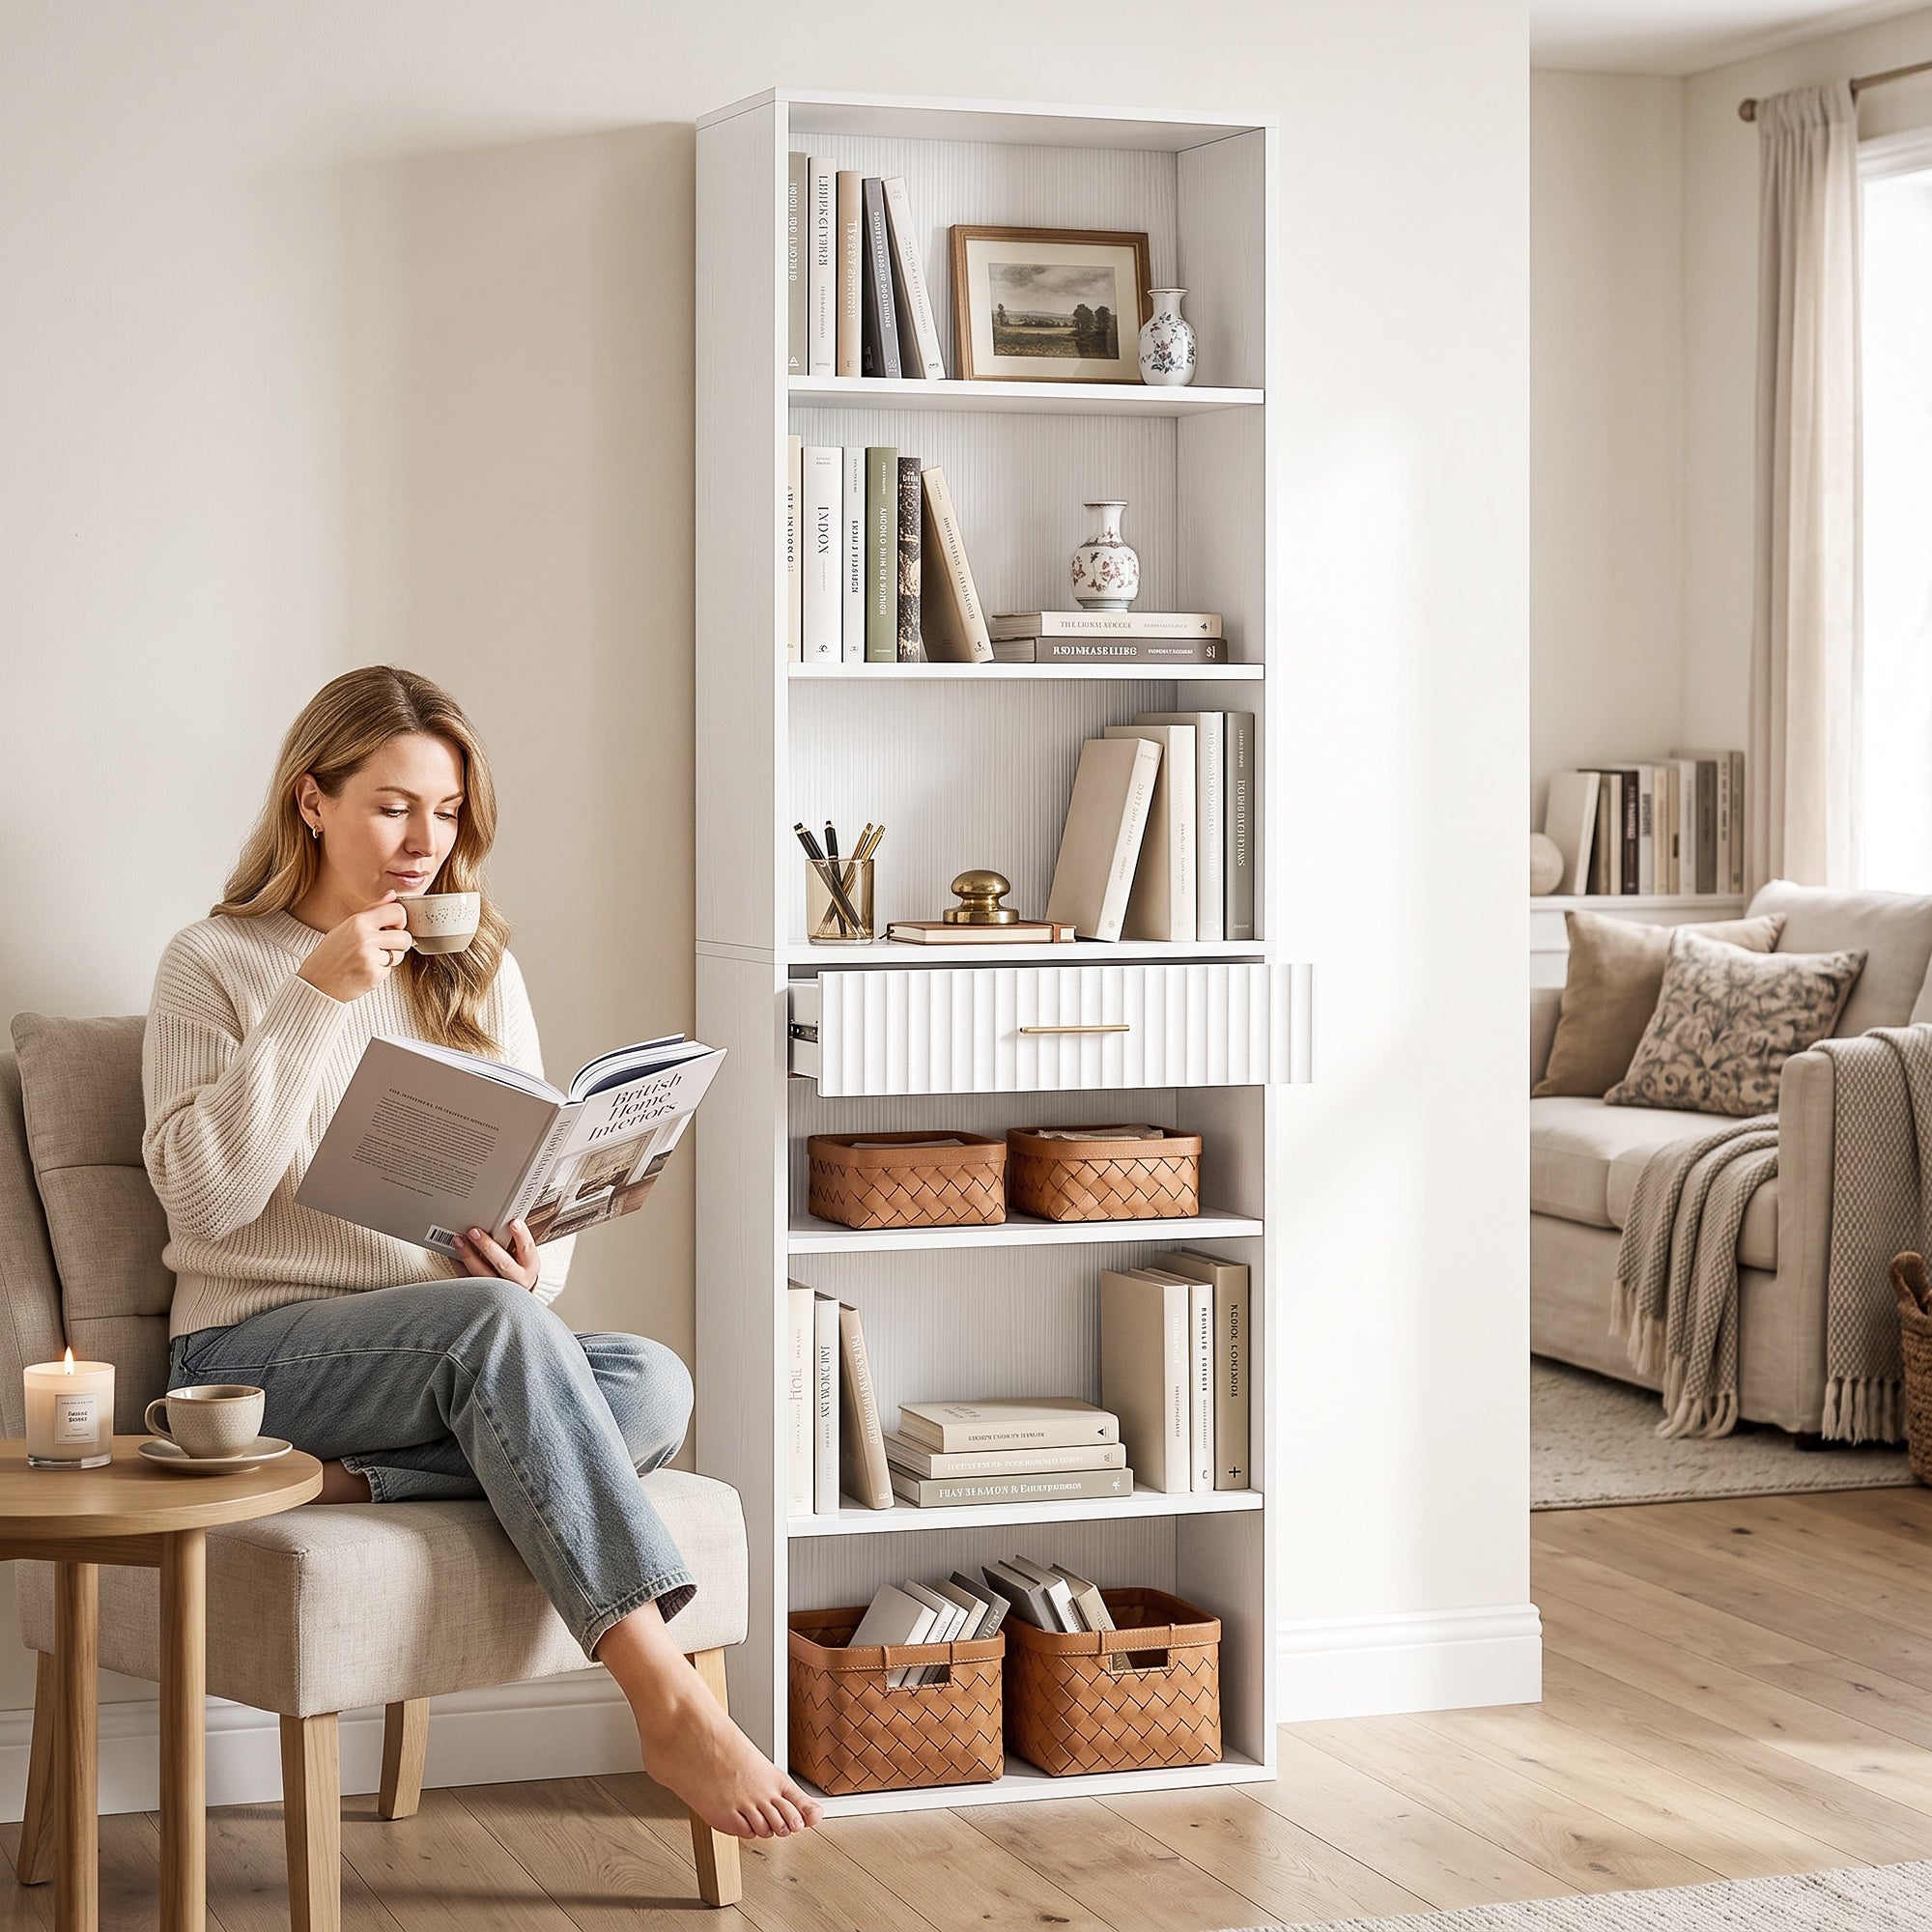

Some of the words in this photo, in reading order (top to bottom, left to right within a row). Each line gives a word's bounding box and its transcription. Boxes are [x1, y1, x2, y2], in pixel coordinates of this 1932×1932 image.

[608, 1092, 672, 1122] Home
[611, 1072, 683, 1108] British
[587, 1100, 678, 1142] Interiors
